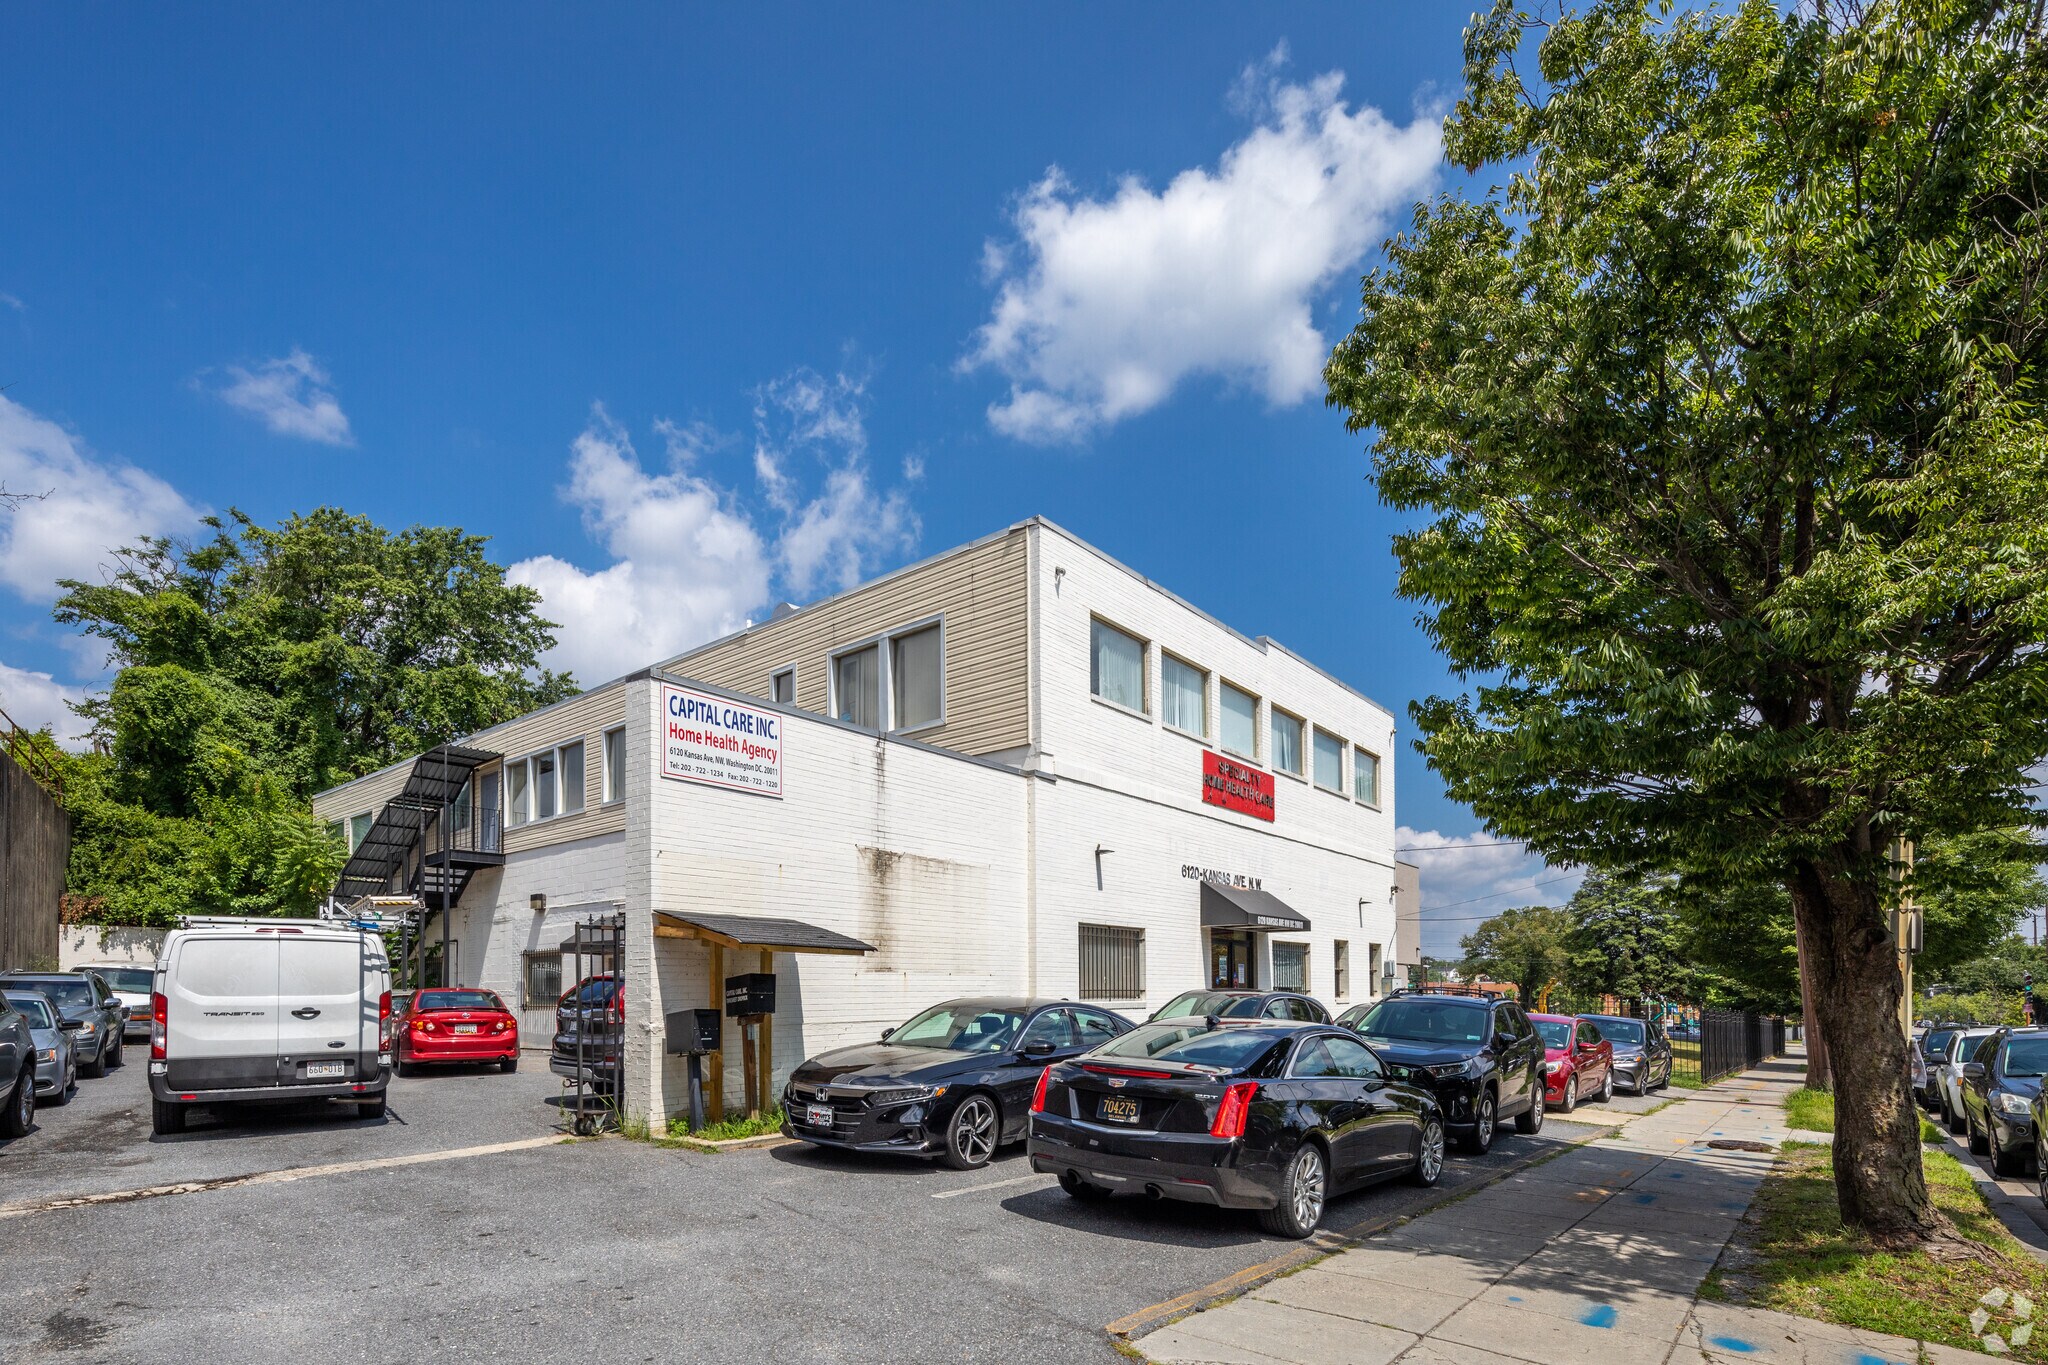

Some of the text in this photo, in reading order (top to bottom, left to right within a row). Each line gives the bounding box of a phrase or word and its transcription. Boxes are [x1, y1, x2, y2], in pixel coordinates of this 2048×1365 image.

[669, 695, 778, 740] CAPITAL CARE INC.
[669, 722, 777, 764] Home Health Agency
[669, 747, 683, 756] 6120
[684, 749, 703, 760] Kansas
[726, 759, 754, 771] Washington
[764, 766, 778, 776] 20011
[669, 761, 680, 770] Tel:
[1218, 761, 1261, 787] SPECIALTY
[727, 772, 739, 781] Fax:
[1203, 773, 1274, 809] HOME HEALTH CARE
[1103, 1099, 1136, 1116] 704275
